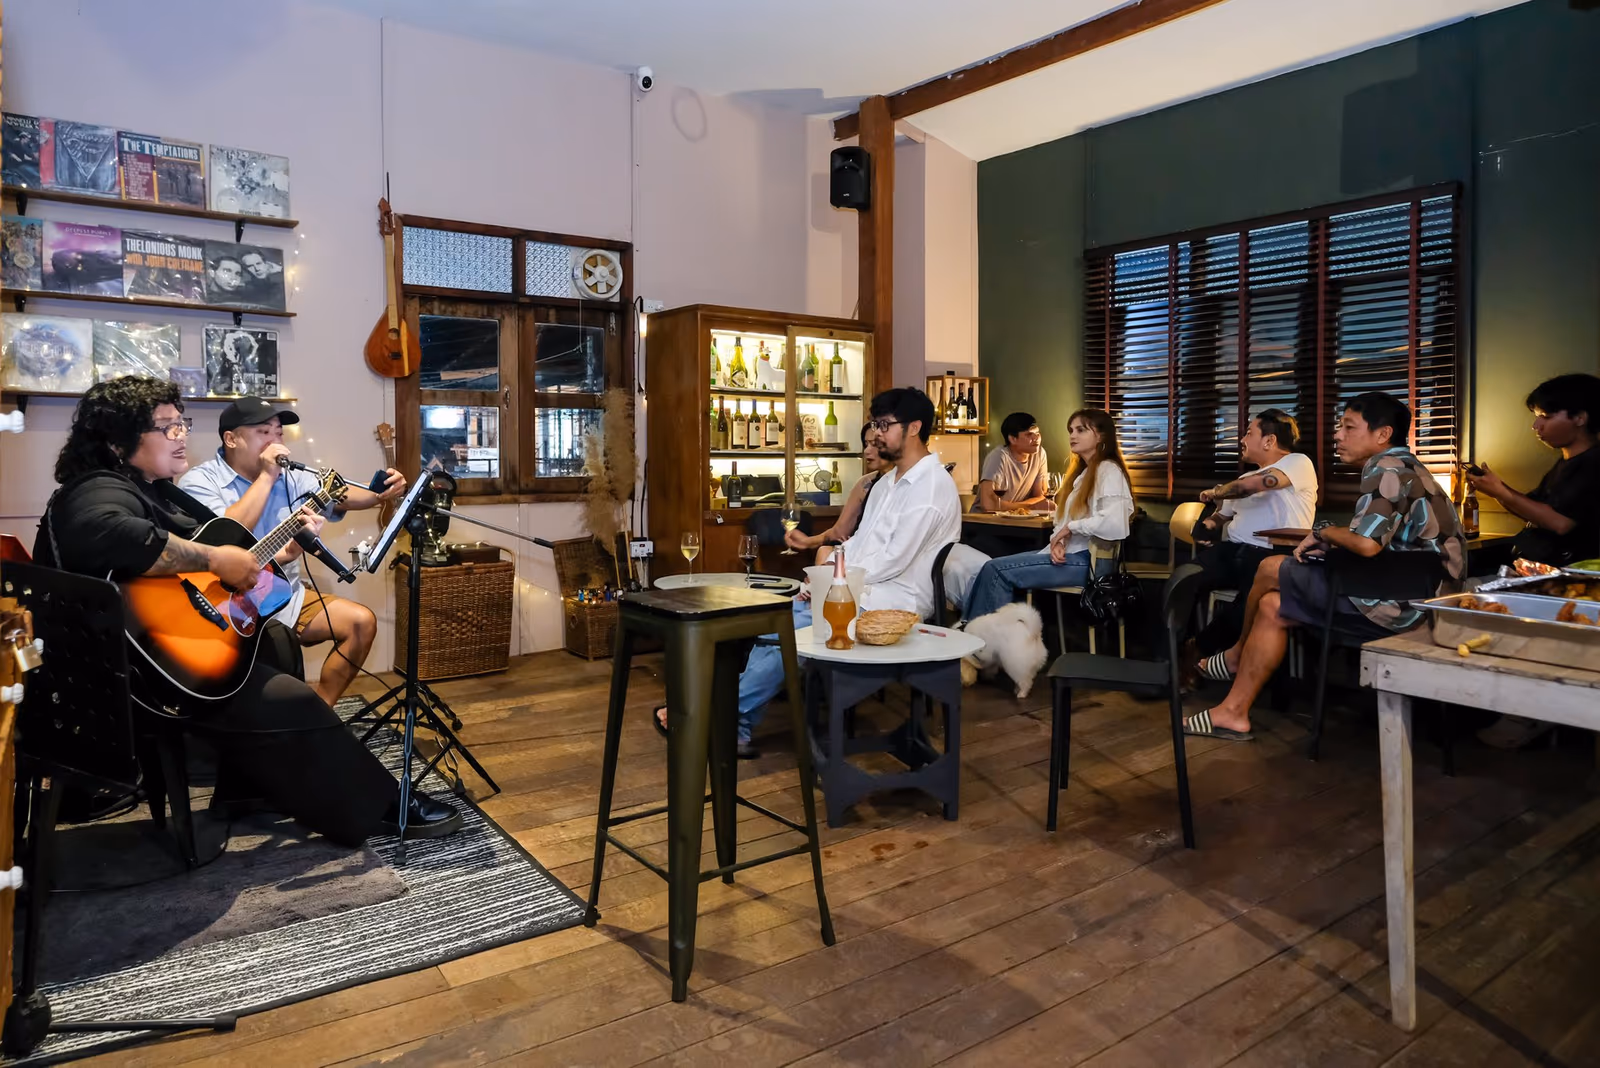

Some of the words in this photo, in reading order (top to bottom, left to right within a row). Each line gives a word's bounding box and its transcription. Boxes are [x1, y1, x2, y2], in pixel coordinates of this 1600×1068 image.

[120, 138, 141, 152] THE
[142, 140, 198, 160] TEMPTATIONS
[126, 238, 176, 257] THELONIOUS
[178, 245, 203, 261] MONK
[144, 254, 166, 269] JOHN
[167, 257, 204, 273] COLTRANE
